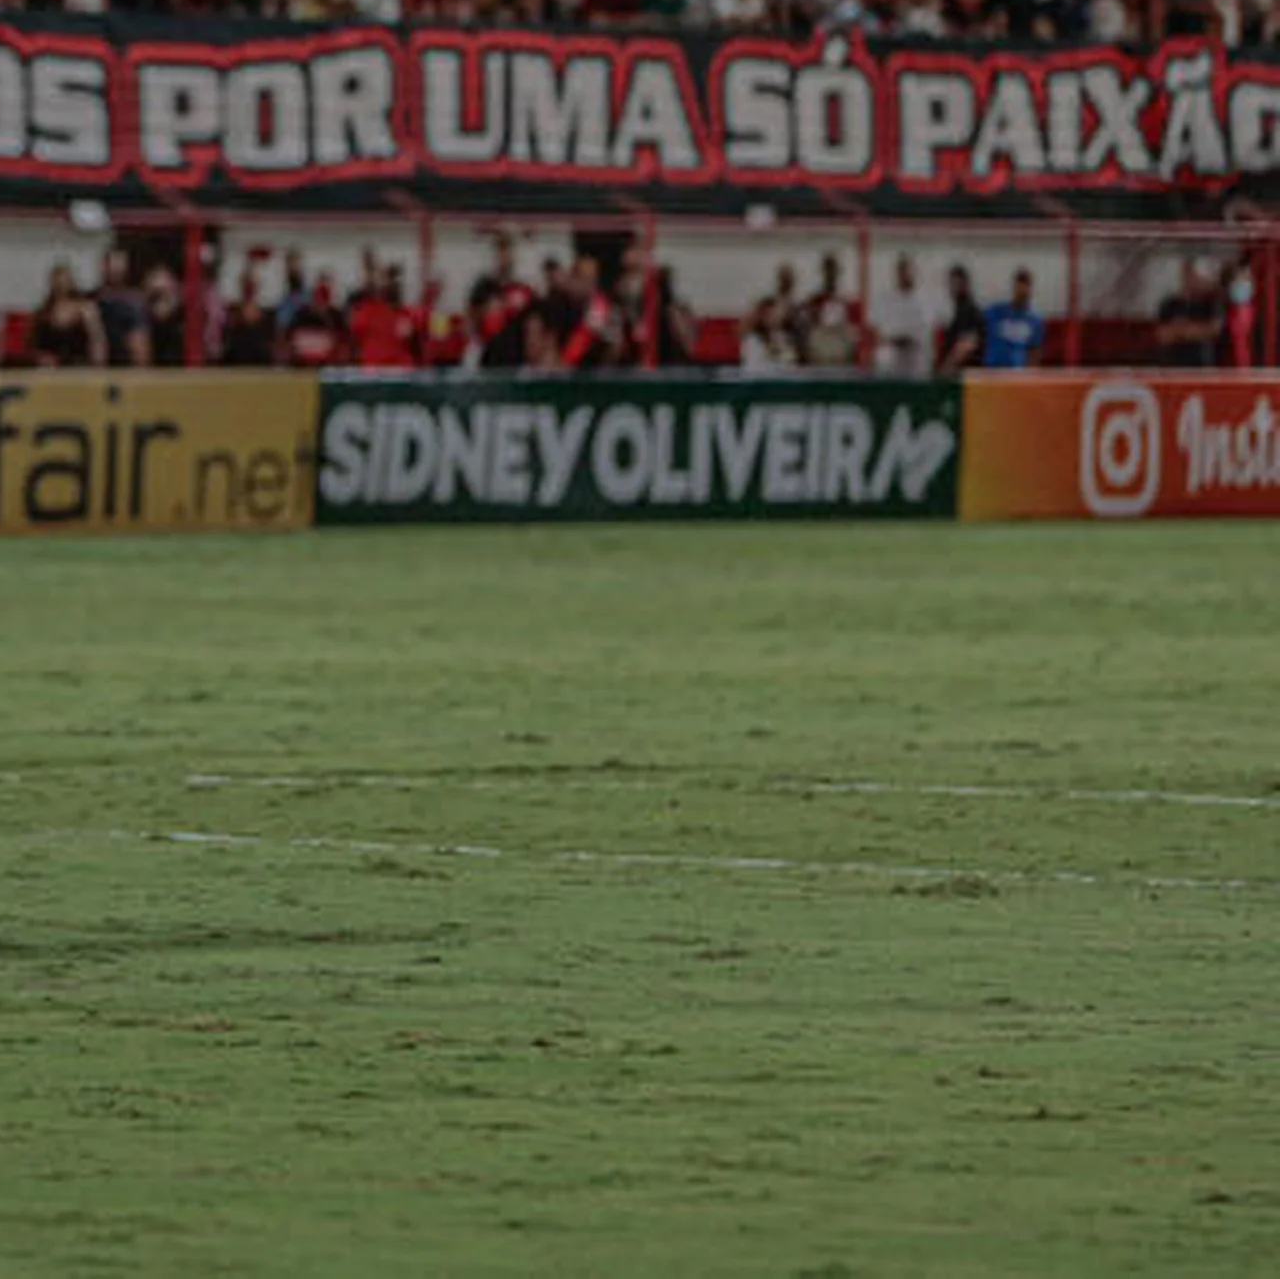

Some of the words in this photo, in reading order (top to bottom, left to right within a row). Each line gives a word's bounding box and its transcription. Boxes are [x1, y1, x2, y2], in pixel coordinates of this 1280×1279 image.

[140, 45, 397, 168] POR
[422, 48, 702, 168] UMA
[723, 36, 872, 175] SÓ
[319, 401, 594, 506] SIDNEY
[1177, 391, 1280, 495] Inst
